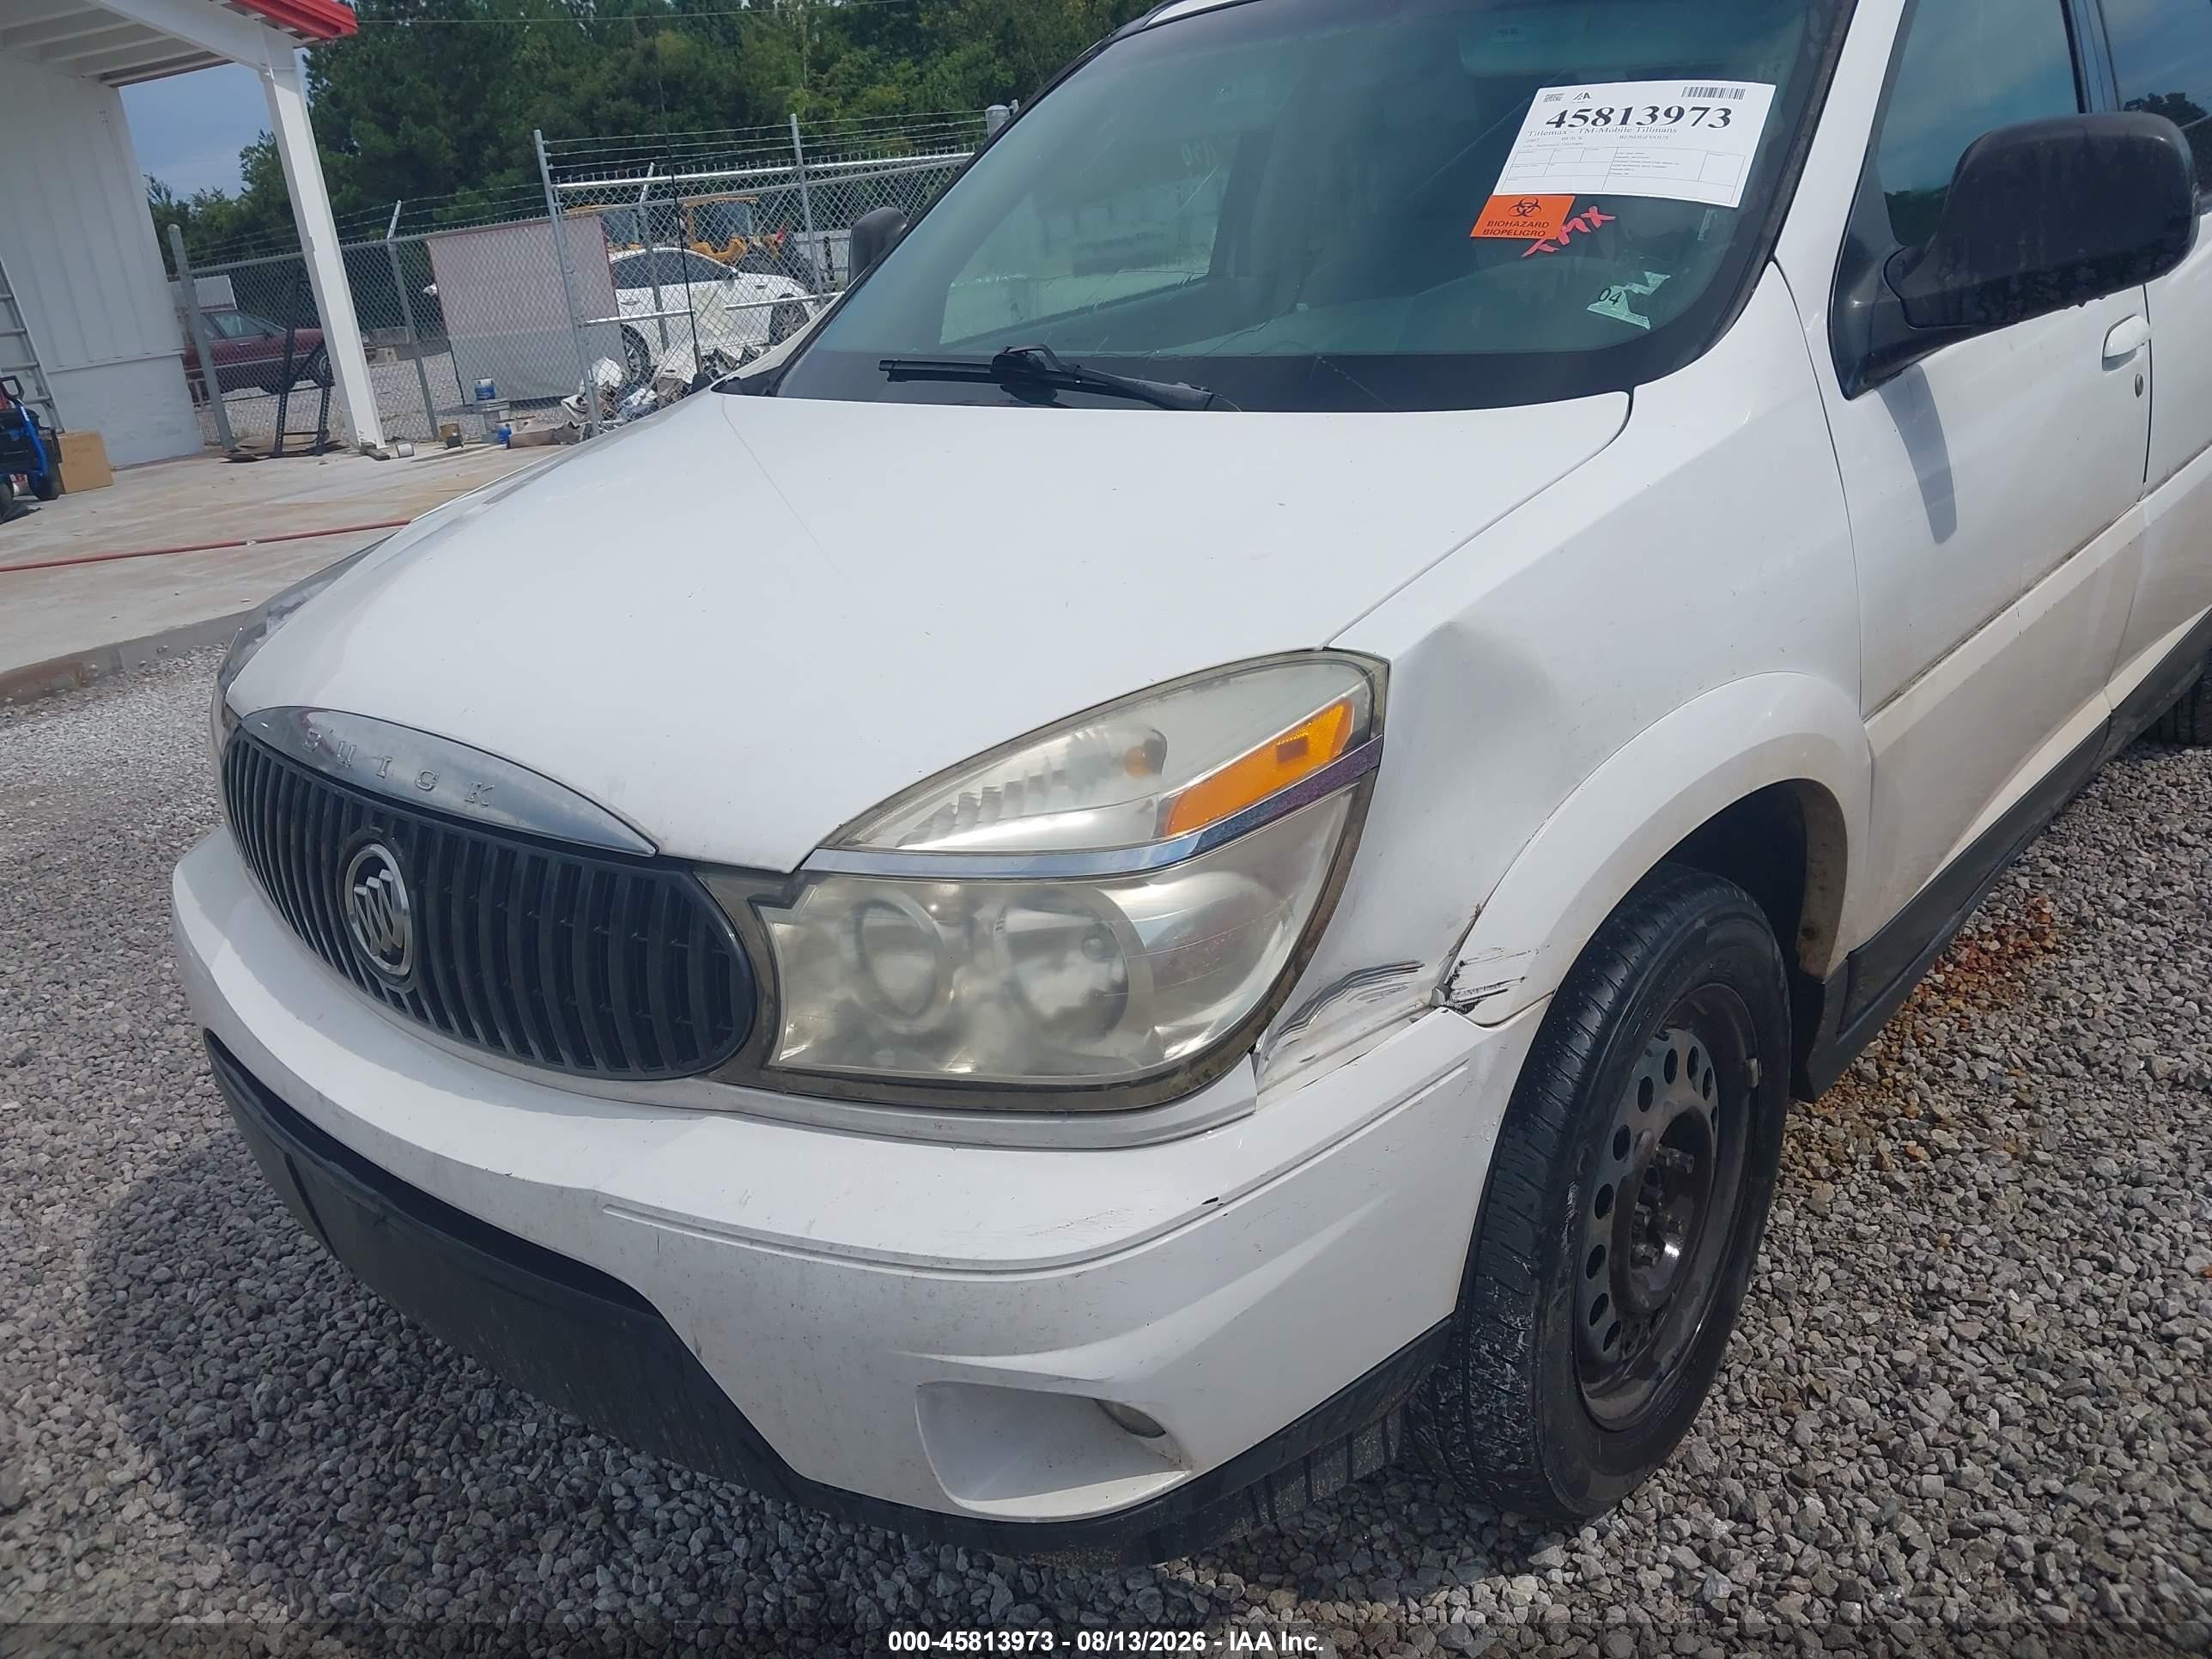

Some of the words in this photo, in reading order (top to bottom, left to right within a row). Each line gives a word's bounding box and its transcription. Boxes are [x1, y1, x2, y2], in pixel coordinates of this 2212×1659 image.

[1545, 105, 1733, 129] 45813973
[1482, 228, 1546, 237] BIOPELIGRO
[1486, 220, 1549, 228] BIOHAZARD
[1598, 288, 1623, 307] 04
[302, 727, 495, 806] BUICK
